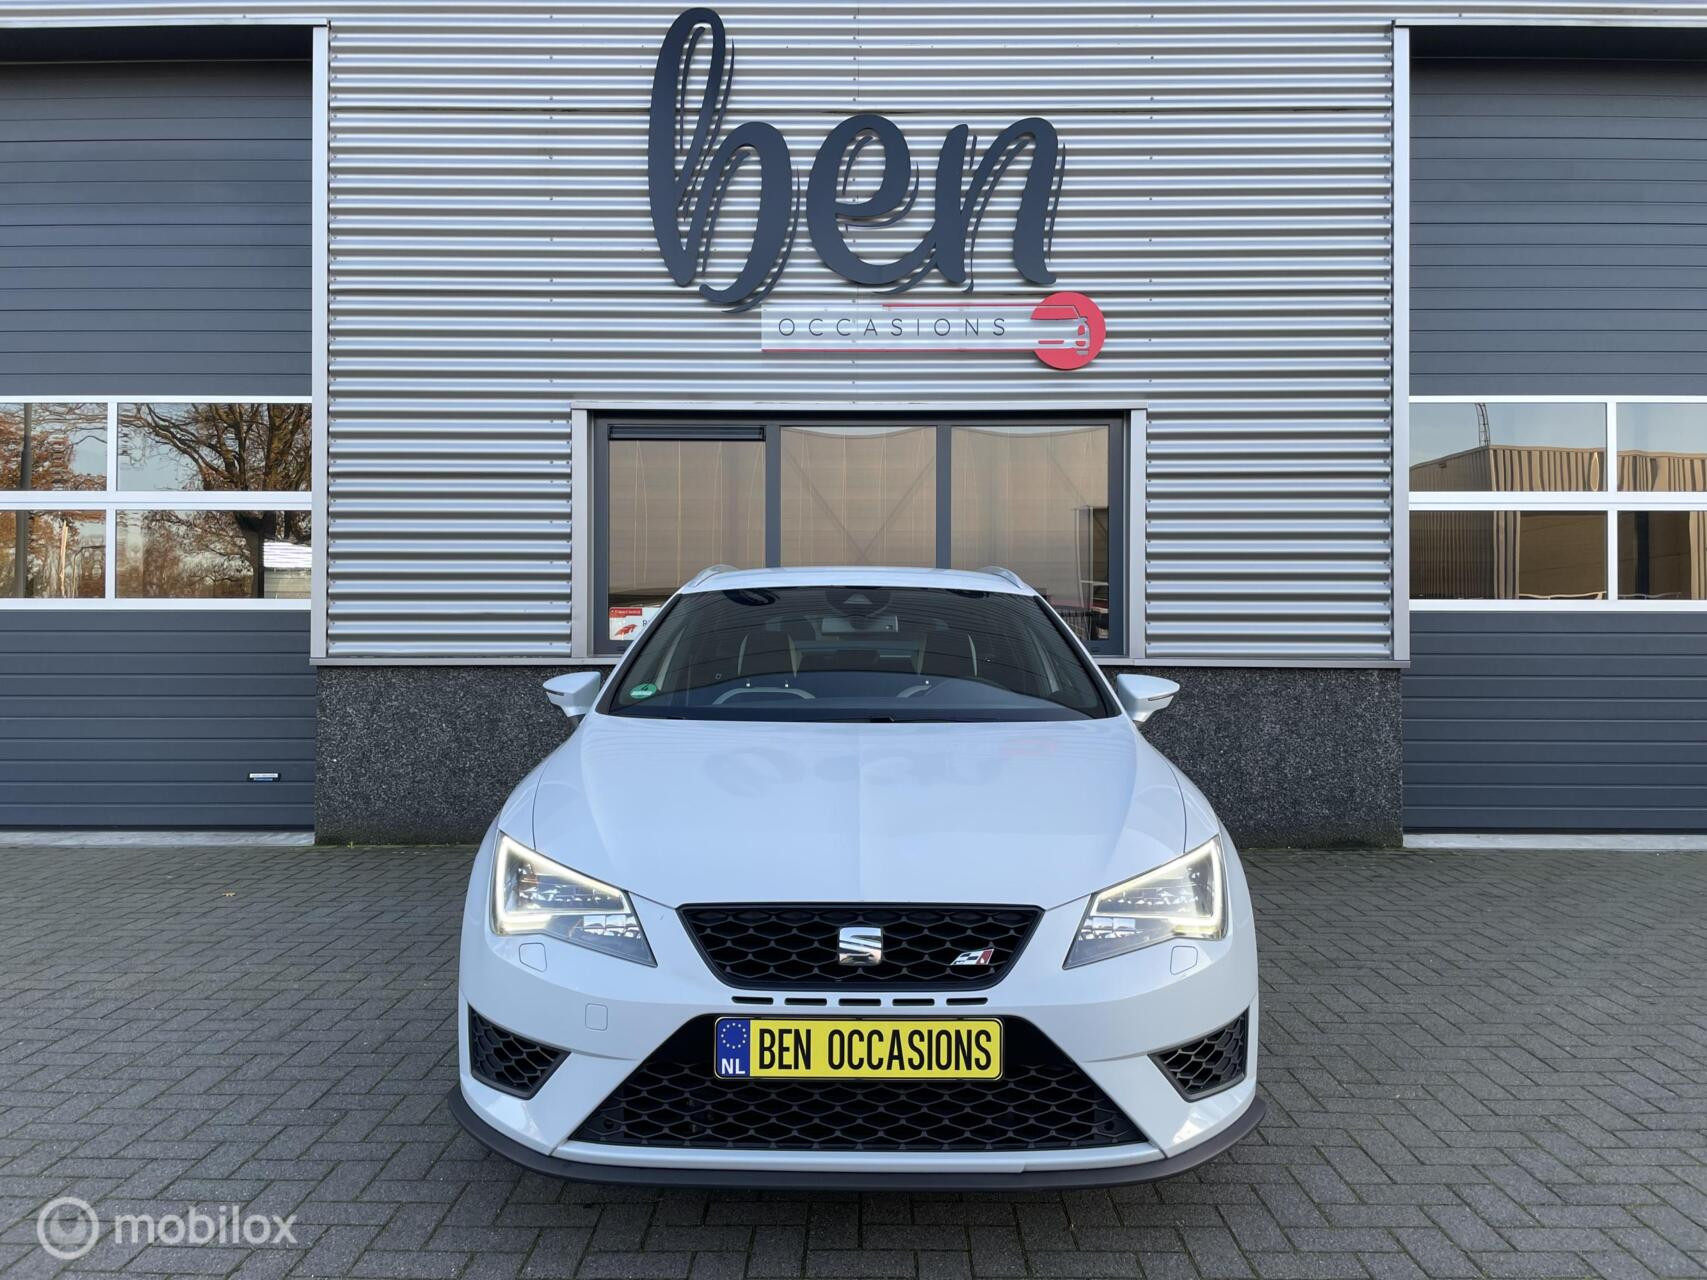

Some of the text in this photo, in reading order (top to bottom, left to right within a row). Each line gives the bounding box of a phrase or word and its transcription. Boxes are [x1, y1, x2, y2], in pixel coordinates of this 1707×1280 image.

[648, 7, 1064, 311] ben
[778, 317, 1006, 337] OCCASIONS
[758, 1028, 992, 1071] BEN OCCASIONS
[721, 1058, 746, 1075] NL
